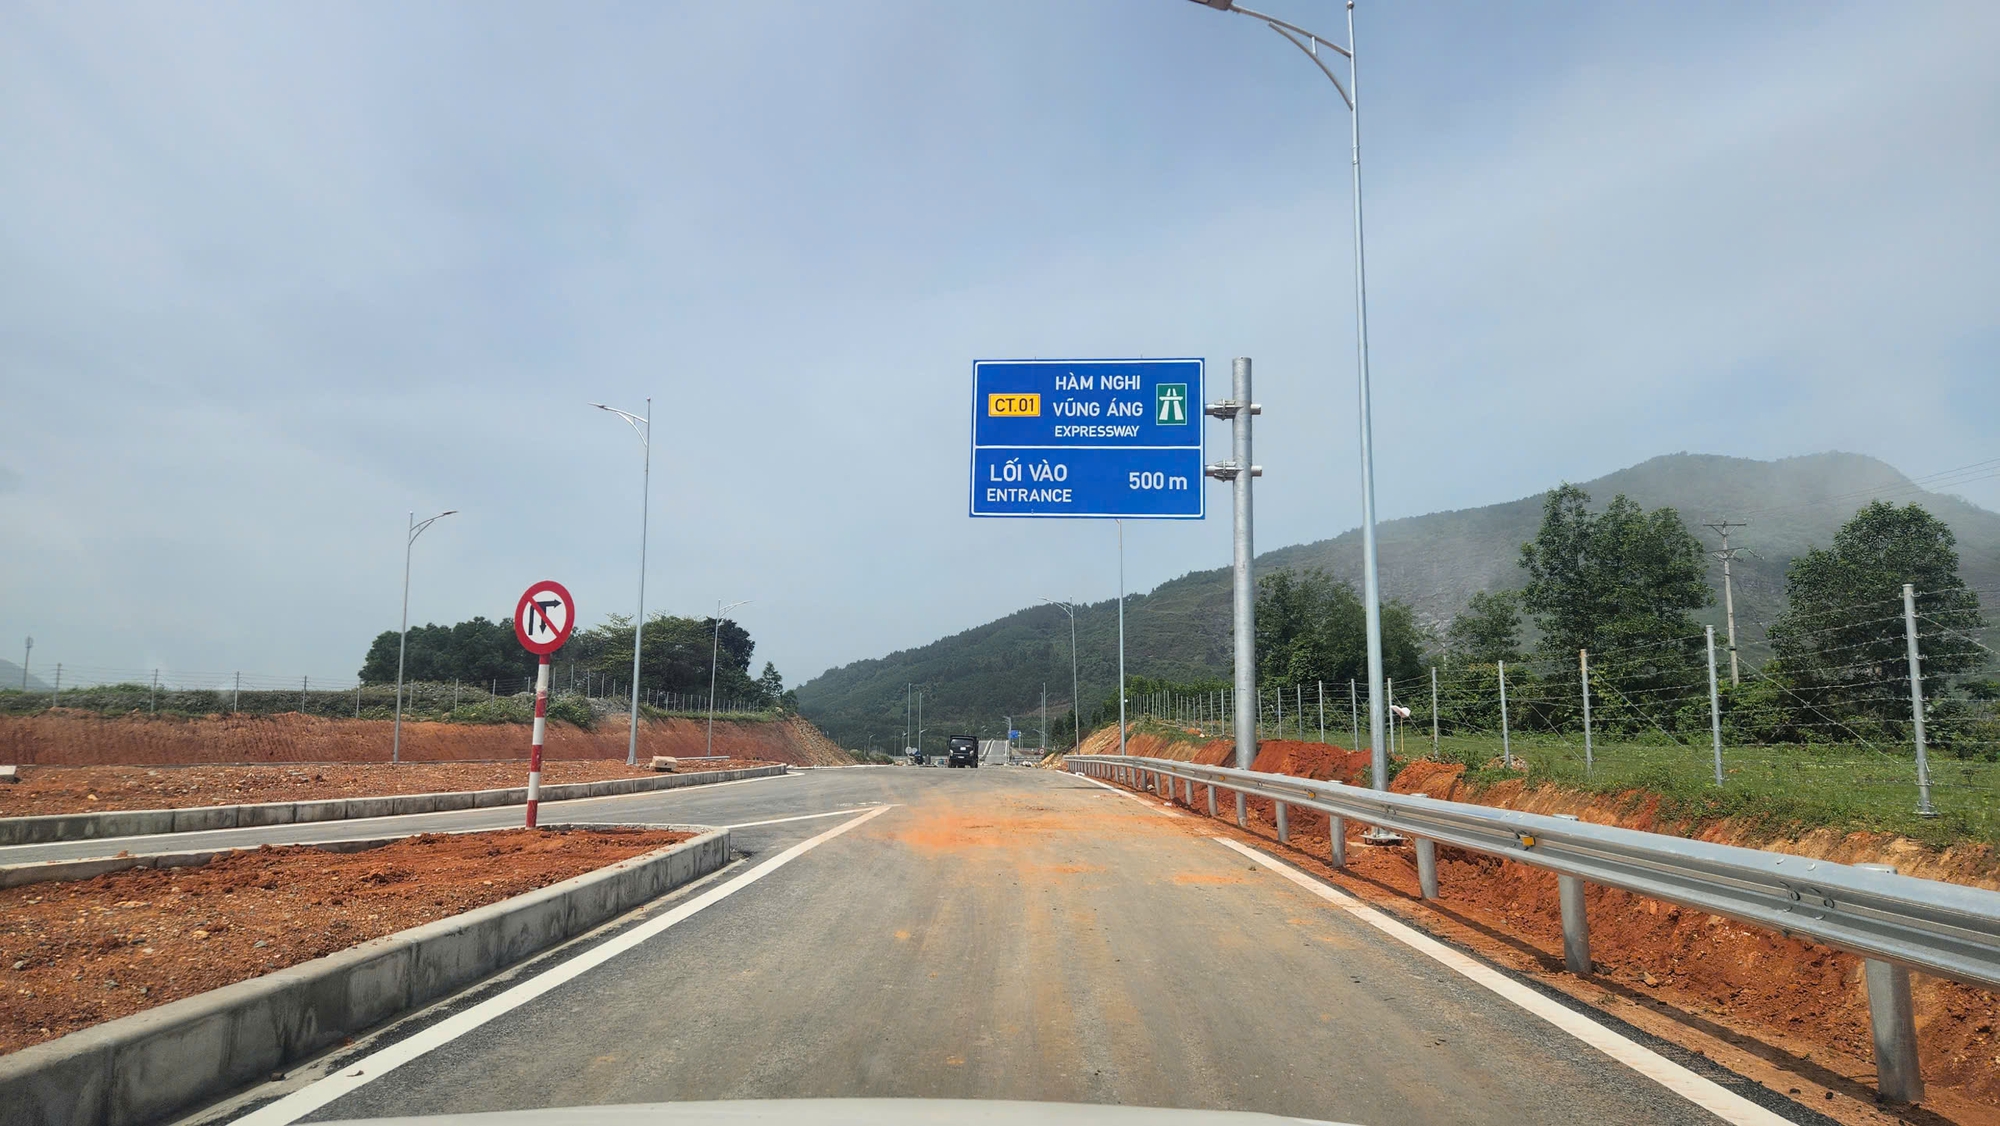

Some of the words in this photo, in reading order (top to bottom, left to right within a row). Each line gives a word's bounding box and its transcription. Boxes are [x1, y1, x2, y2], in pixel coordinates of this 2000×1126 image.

[1055, 372, 1094, 390] HÀM
[1101, 375, 1141, 390] NGHI
[995, 398, 1034, 412] CT.01
[1052, 398, 1100, 416] VŨNG
[1107, 398, 1143, 416] ÁNG
[1054, 425, 1140, 438] EXPRESSWAY
[990, 458, 1022, 482] LỐI
[1029, 459, 1068, 482] VÀO
[1129, 472, 1164, 490] 500
[1169, 477, 1188, 490] m
[987, 488, 1072, 503] ENTRANCE
